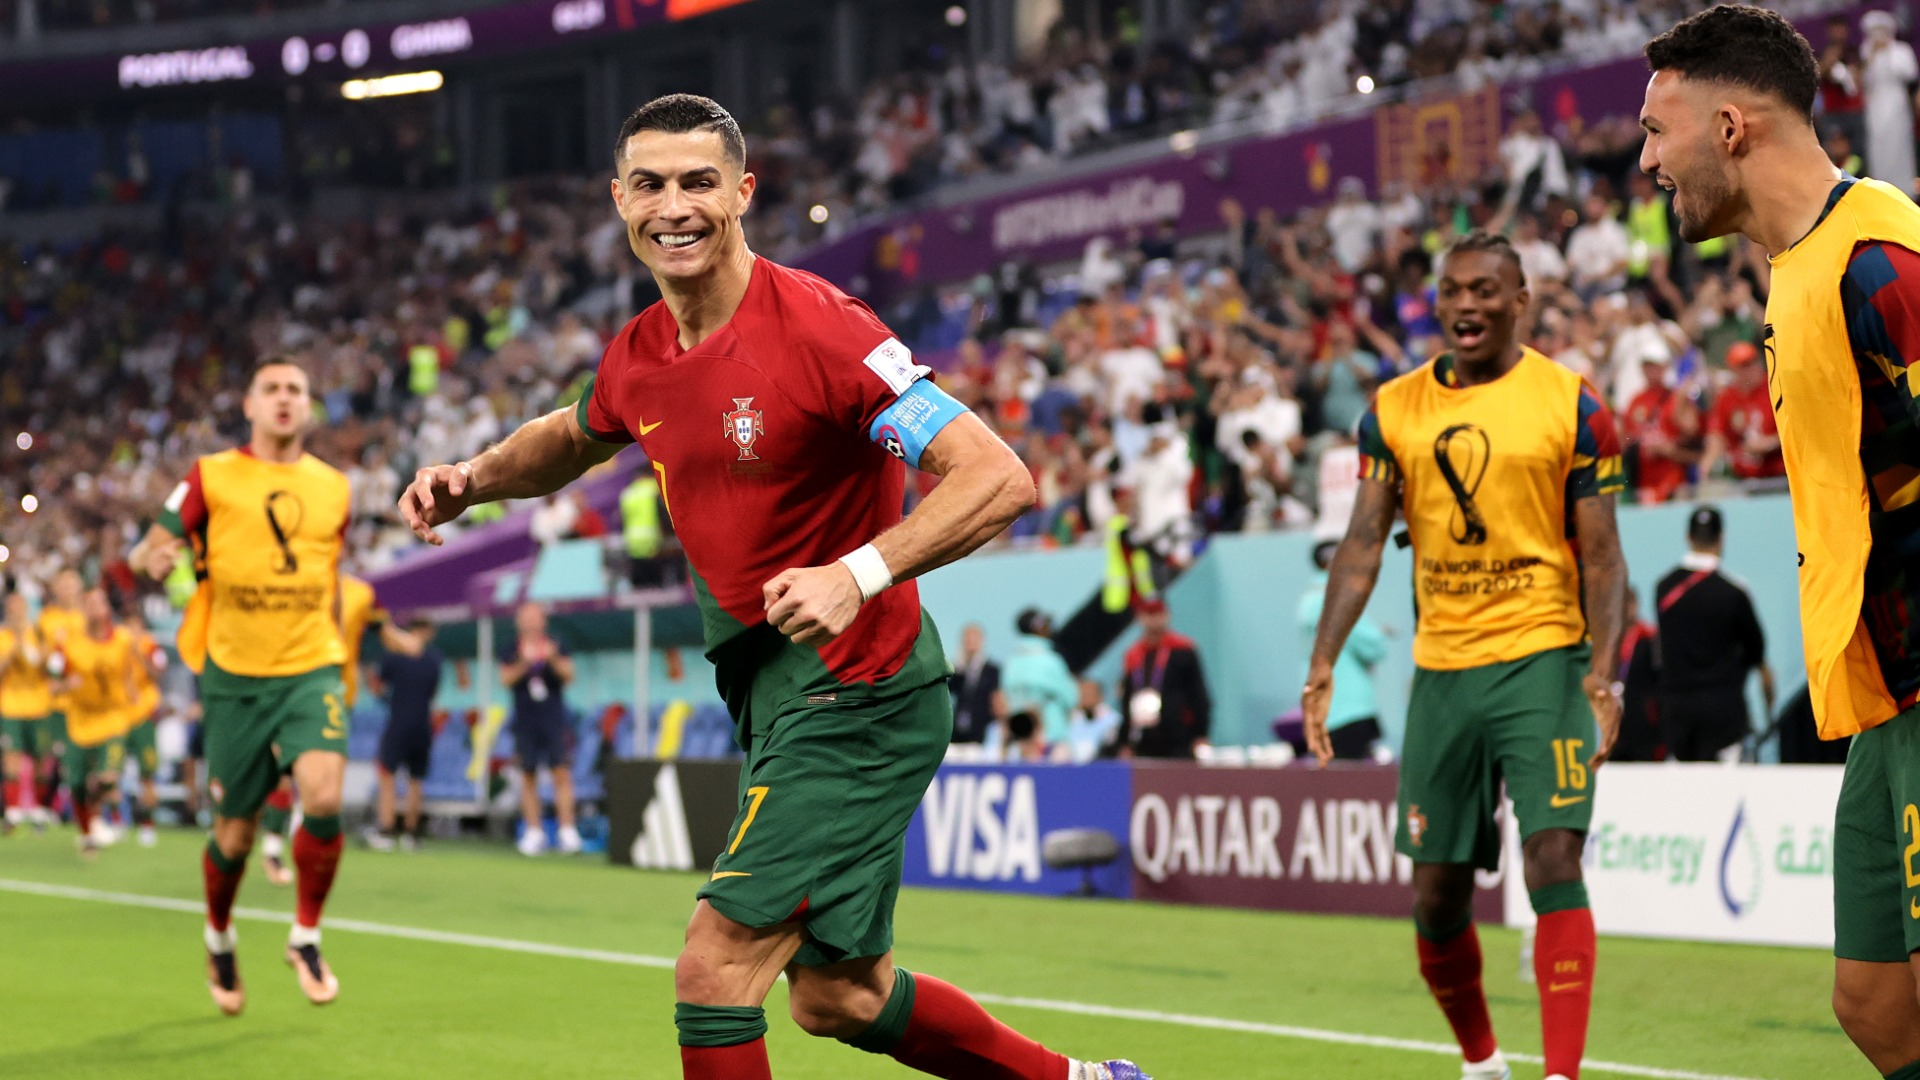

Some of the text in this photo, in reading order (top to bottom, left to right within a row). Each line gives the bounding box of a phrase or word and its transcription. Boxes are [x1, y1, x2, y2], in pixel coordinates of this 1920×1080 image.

[118, 46, 254, 88] PORTUGAL
[890, 392, 921, 422] FOOTBALL
[898, 396, 931, 428] UNITES
[919, 403, 940, 424] World
[1552, 739, 1587, 790] 15
[728, 786, 770, 855] 7
[921, 773, 1042, 883] VISA
[1129, 793, 1284, 883] QATAR
